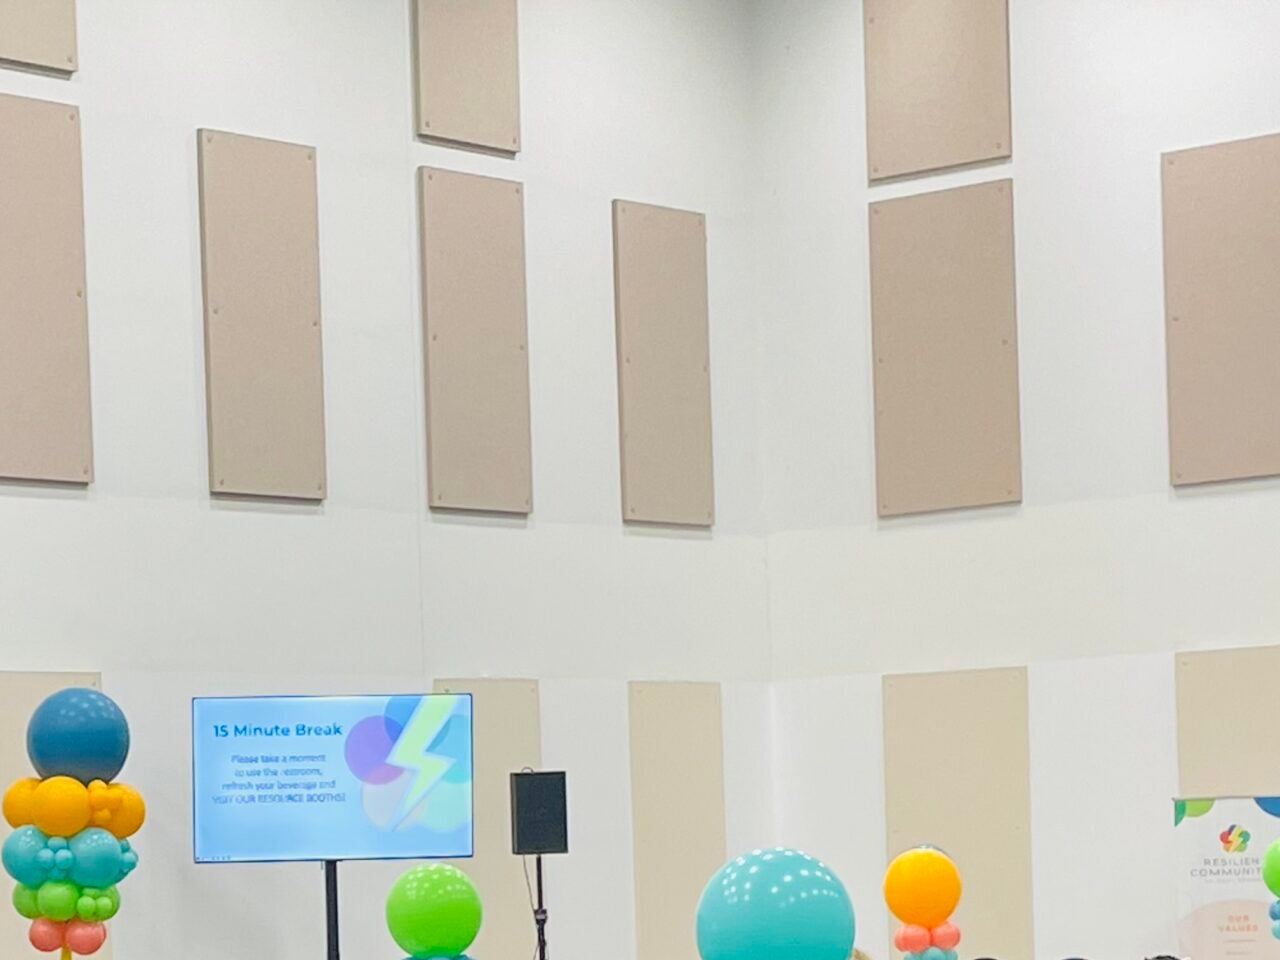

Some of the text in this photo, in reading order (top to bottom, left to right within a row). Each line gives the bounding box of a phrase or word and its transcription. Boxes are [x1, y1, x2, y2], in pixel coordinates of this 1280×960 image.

[213, 723, 343, 737] 15 Minute Break
[1203, 857, 1260, 866] RESILIEN
[1190, 867, 1261, 877] COMMUNIT
